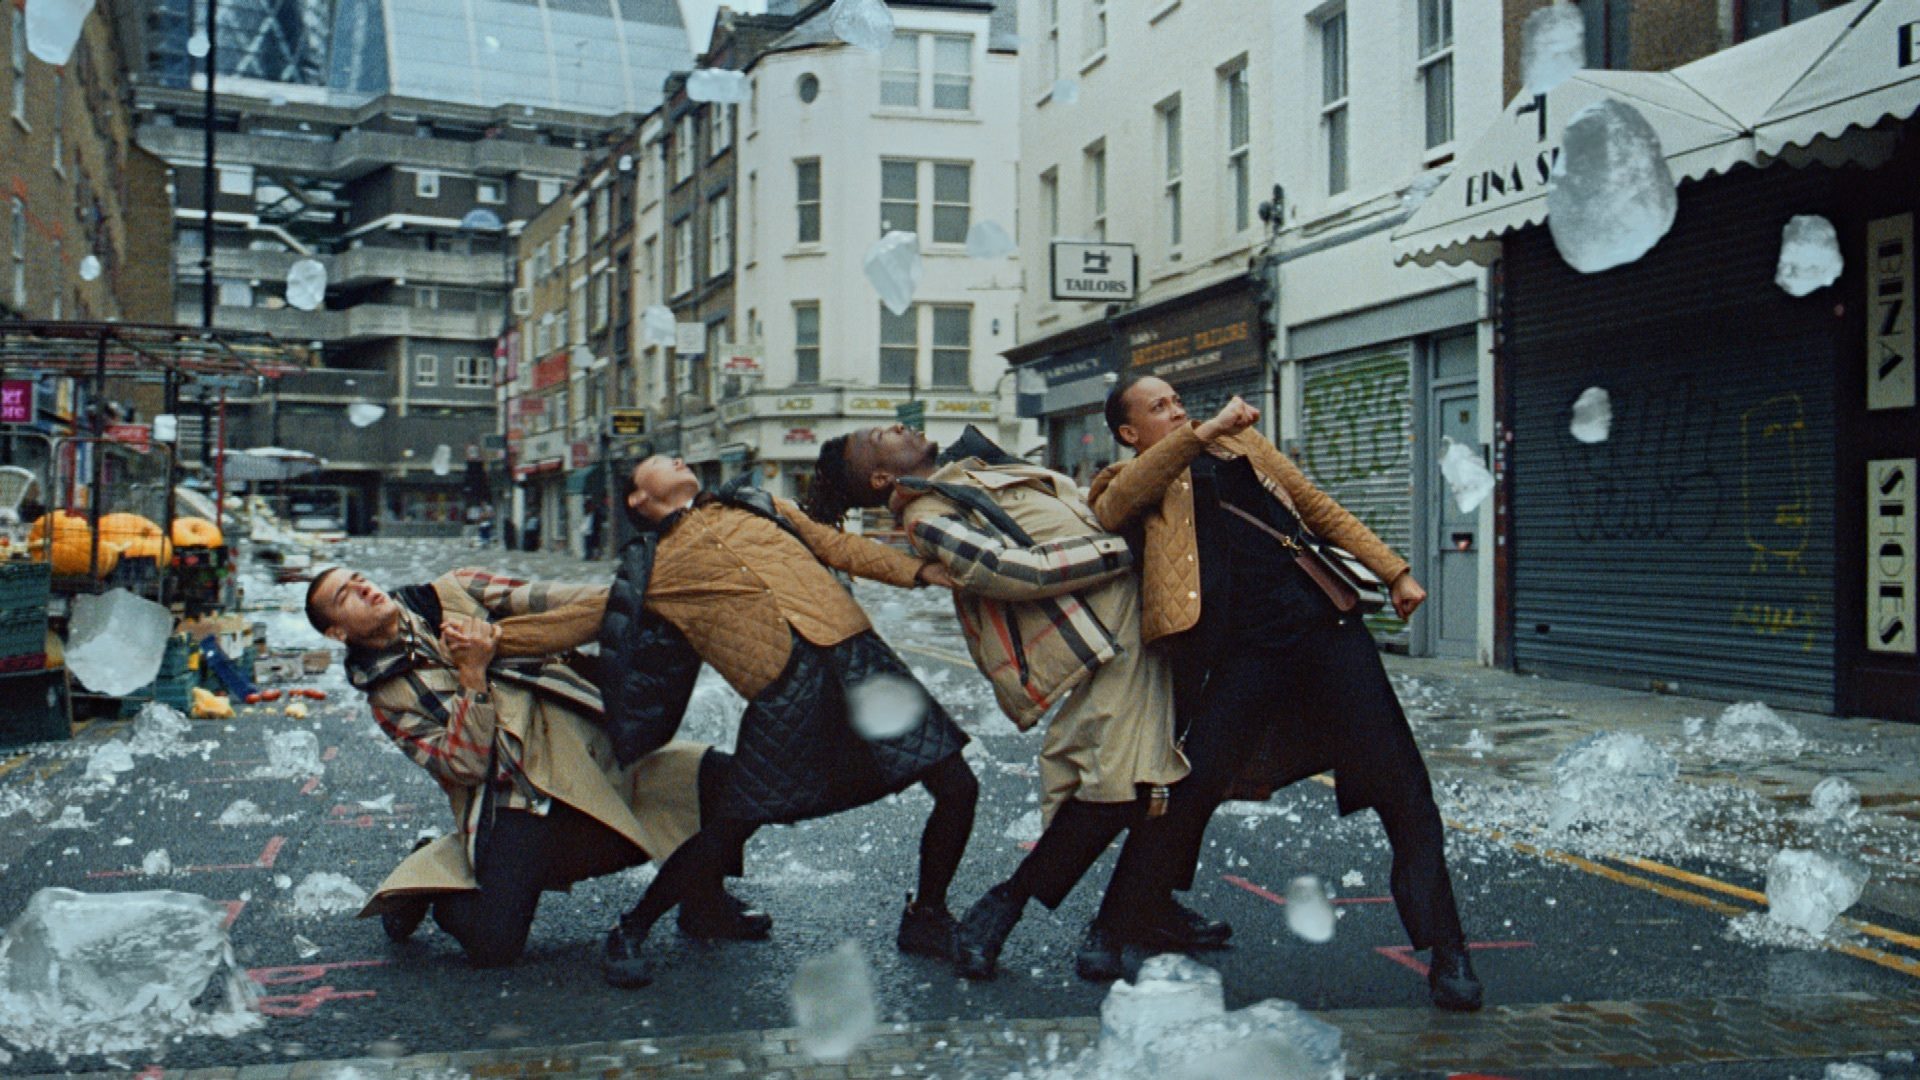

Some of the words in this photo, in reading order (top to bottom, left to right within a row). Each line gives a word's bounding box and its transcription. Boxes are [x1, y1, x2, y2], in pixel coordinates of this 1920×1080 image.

[1465, 160, 1524, 207] BINA
[1064, 278, 1128, 293] TAILORS
[1878, 238, 1905, 383] BINA
[1879, 466, 1905, 645] SHOES
